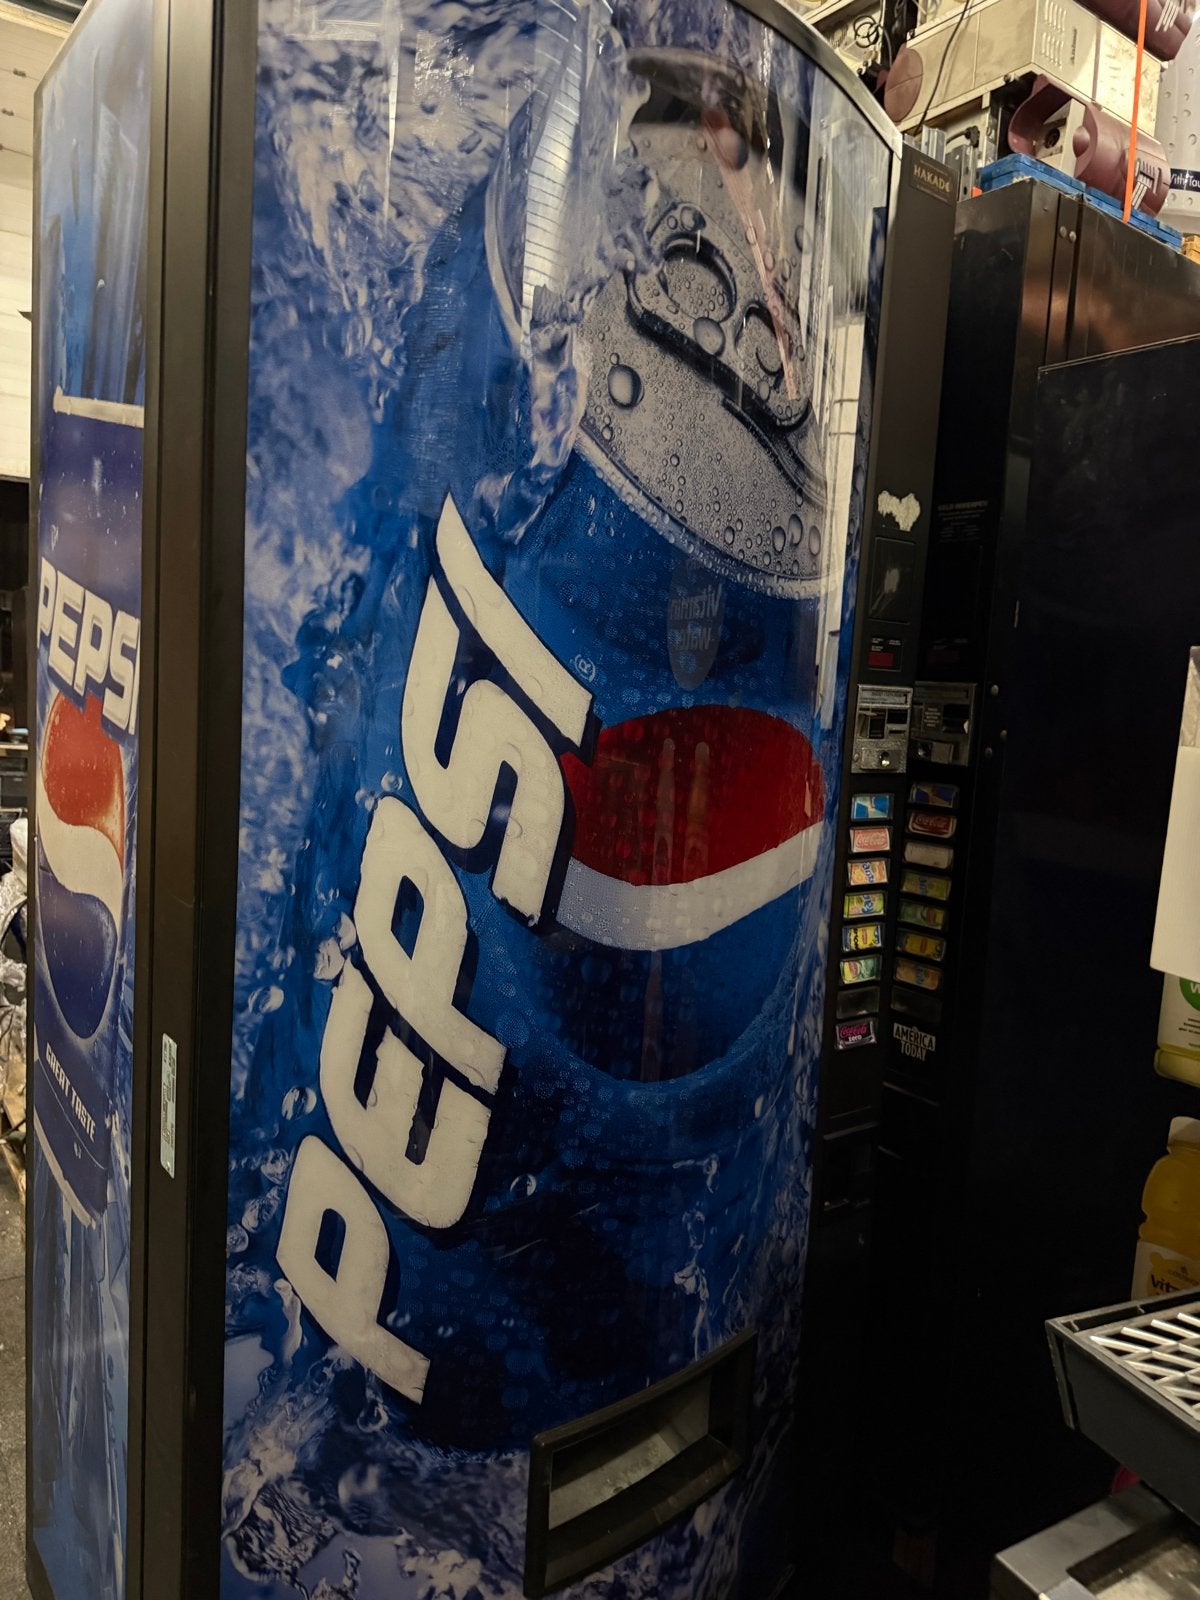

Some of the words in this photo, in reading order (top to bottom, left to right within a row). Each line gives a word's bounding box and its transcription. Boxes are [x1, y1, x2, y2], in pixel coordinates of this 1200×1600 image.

[276, 490, 593, 1404] PEPSI
[894, 1024, 935, 1050] AMERICA
[900, 1040, 927, 1060] TODAY
[46, 1042, 71, 1098] GREAT
[71, 1086, 96, 1143] TASTE
